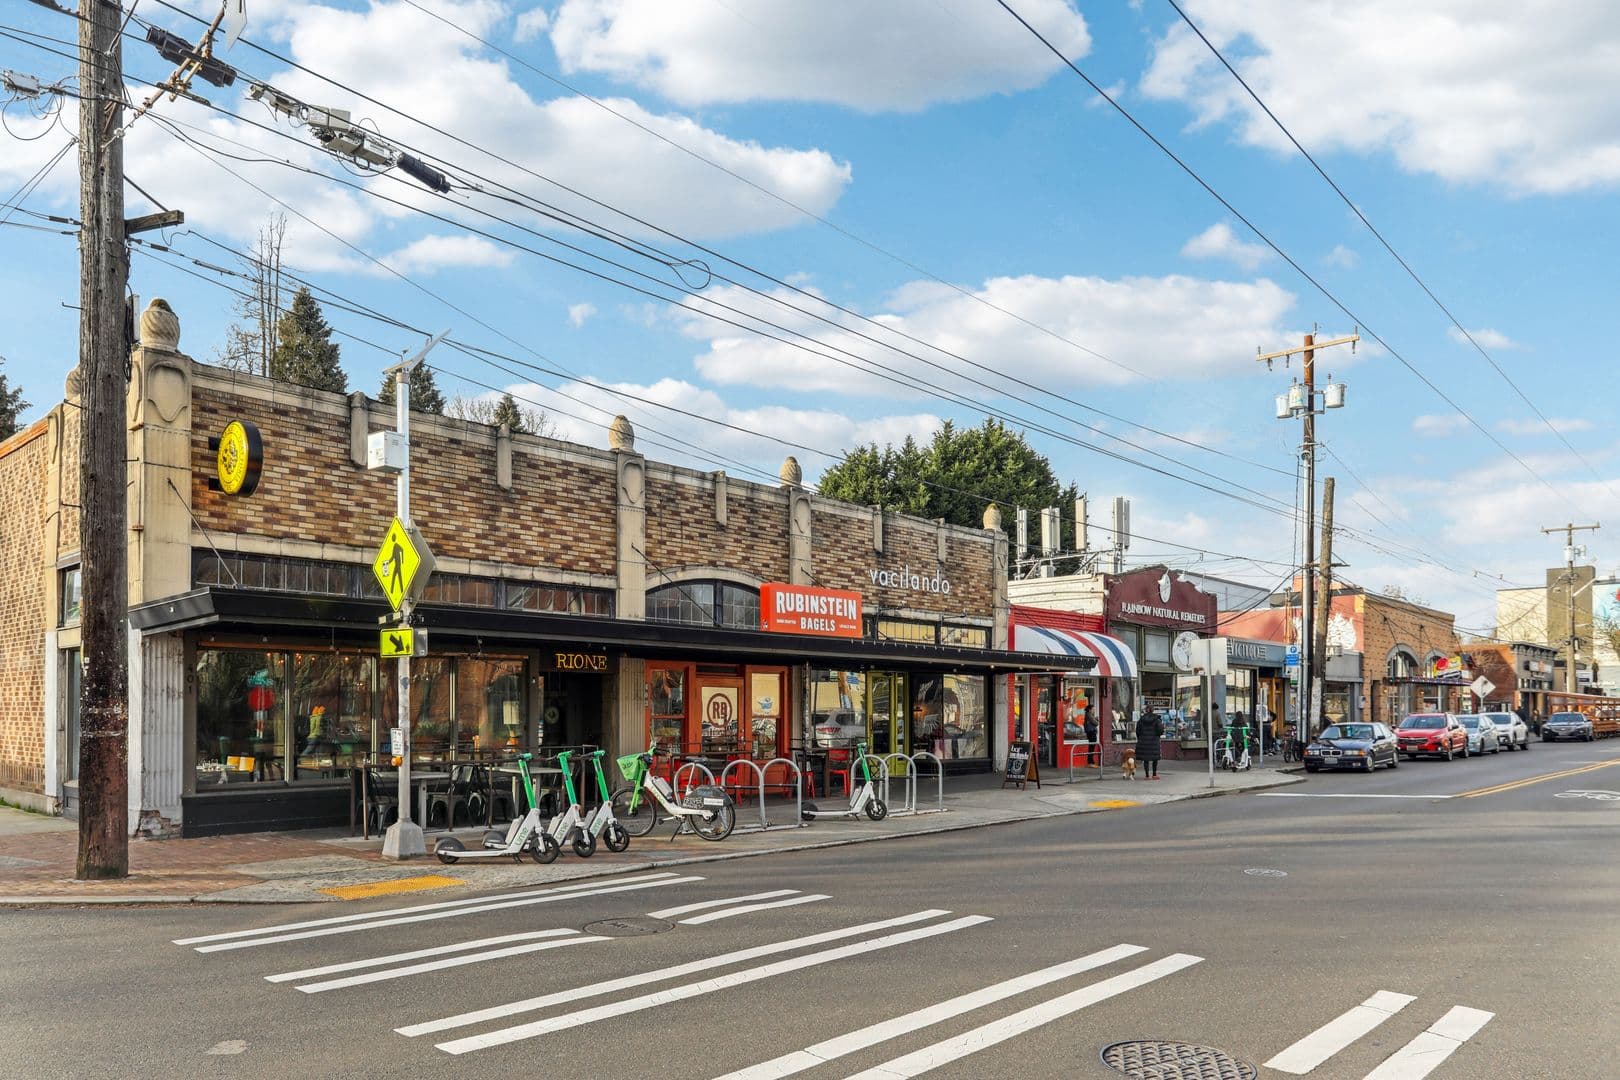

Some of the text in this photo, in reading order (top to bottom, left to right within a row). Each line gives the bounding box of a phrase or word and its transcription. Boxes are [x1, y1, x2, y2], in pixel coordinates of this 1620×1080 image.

[870, 564, 950, 594] vacilando
[776, 591, 857, 620] RUBINSTEIN
[1121, 601, 1152, 616] RAINBOW
[1153, 607, 1180, 619] NATURAL
[800, 616, 836, 632] BAGELS
[555, 653, 607, 670] RIONE
[712, 701, 728, 719] RB
